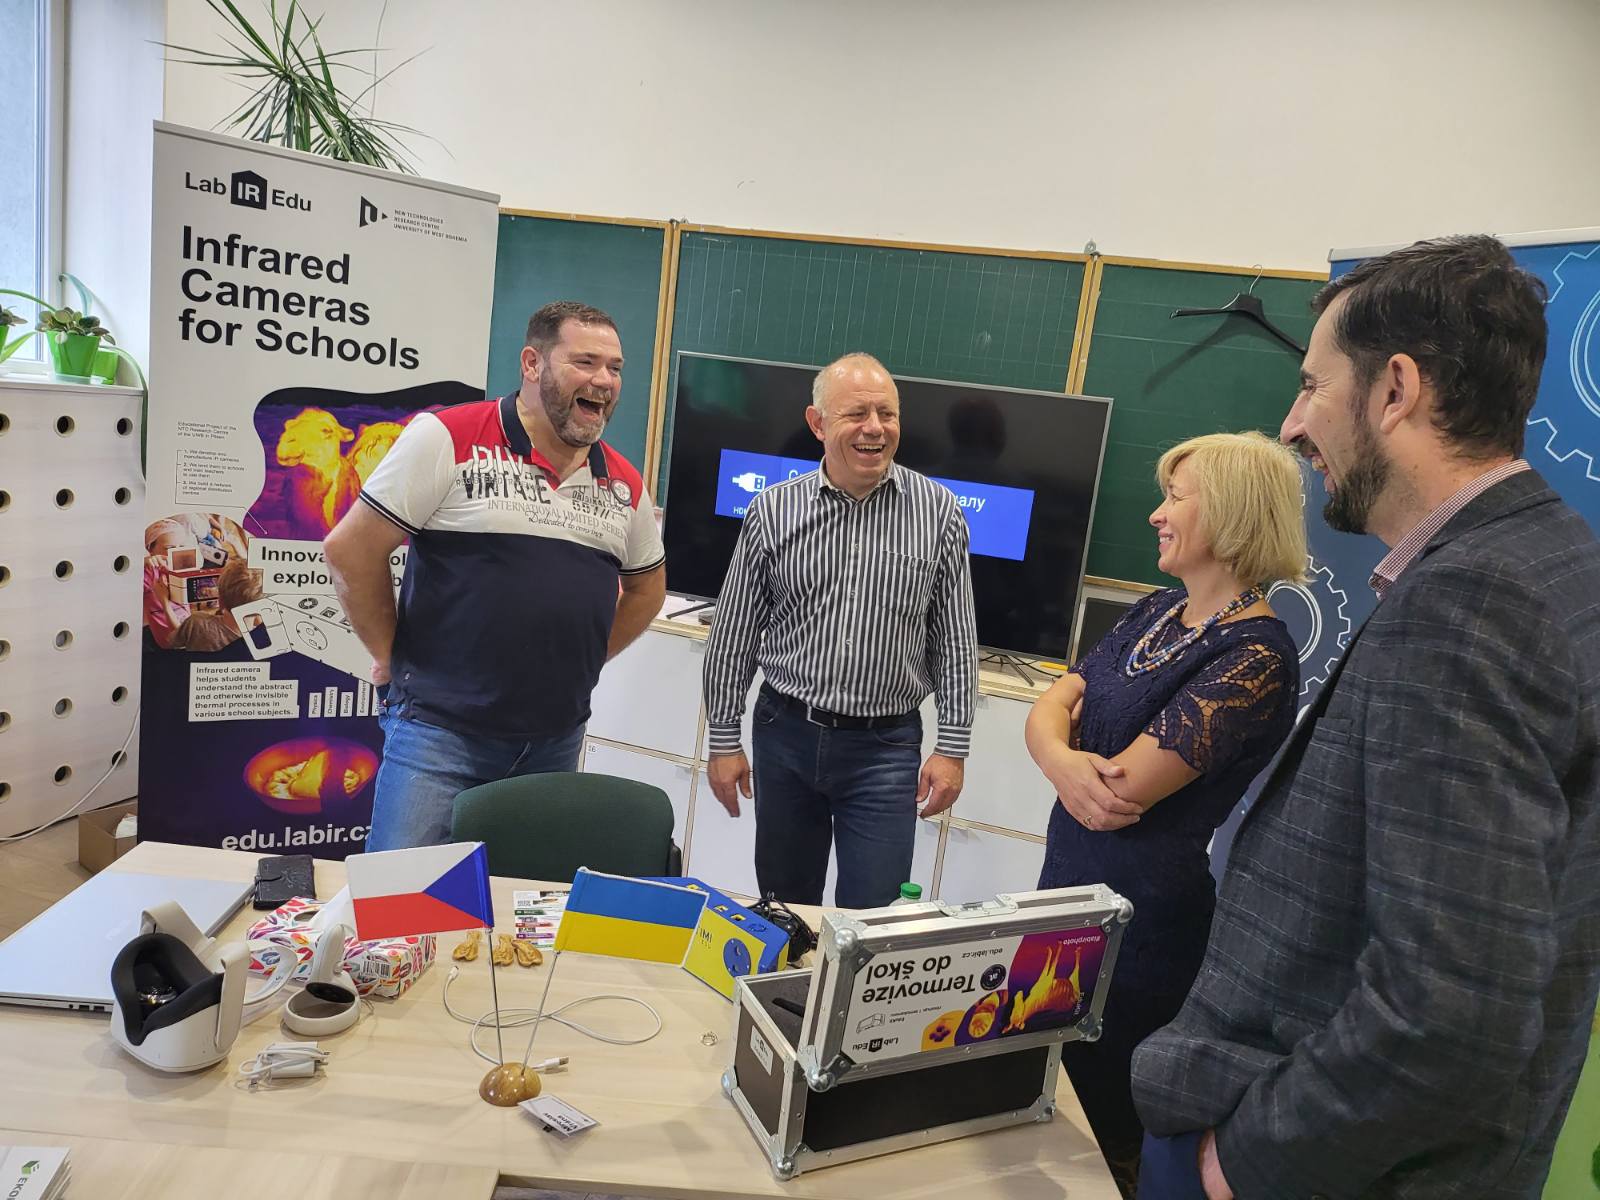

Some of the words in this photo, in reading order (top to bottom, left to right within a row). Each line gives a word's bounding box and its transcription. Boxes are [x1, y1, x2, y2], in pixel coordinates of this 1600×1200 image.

[185, 171, 227, 195] Lab
[237, 181, 260, 203] IR
[271, 188, 312, 212] Edu
[394, 209, 406, 217] NEW
[407, 211, 443, 224] TECHNOLOGIES
[394, 216, 420, 226] RESEARCH
[421, 222, 440, 230] CENTRE
[393, 223, 423, 233] UNIVERSITY
[431, 231, 445, 239] WEST
[445, 234, 468, 242] BOHEMIA
[182, 225, 350, 285] Infrared
[181, 267, 371, 326] Cameras
[178, 307, 243, 346] for
[255, 318, 420, 370] Schools
[488, 499, 560, 520] INTERNATIONAL
[562, 509, 600, 528] LIMITED
[196, 675, 219, 683] helps
[213, 692, 254, 700] otherwise
[228, 701, 270, 709] processes
[257, 709, 294, 717] subjects.
[961, 947, 1004, 959] edu.labir.cz
[865, 959, 916, 985] škol
[923, 955, 951, 975] do
[862, 974, 976, 1005] Termovize
[852, 1042, 868, 1051] Edu
[884, 1037, 899, 1046] Lab
